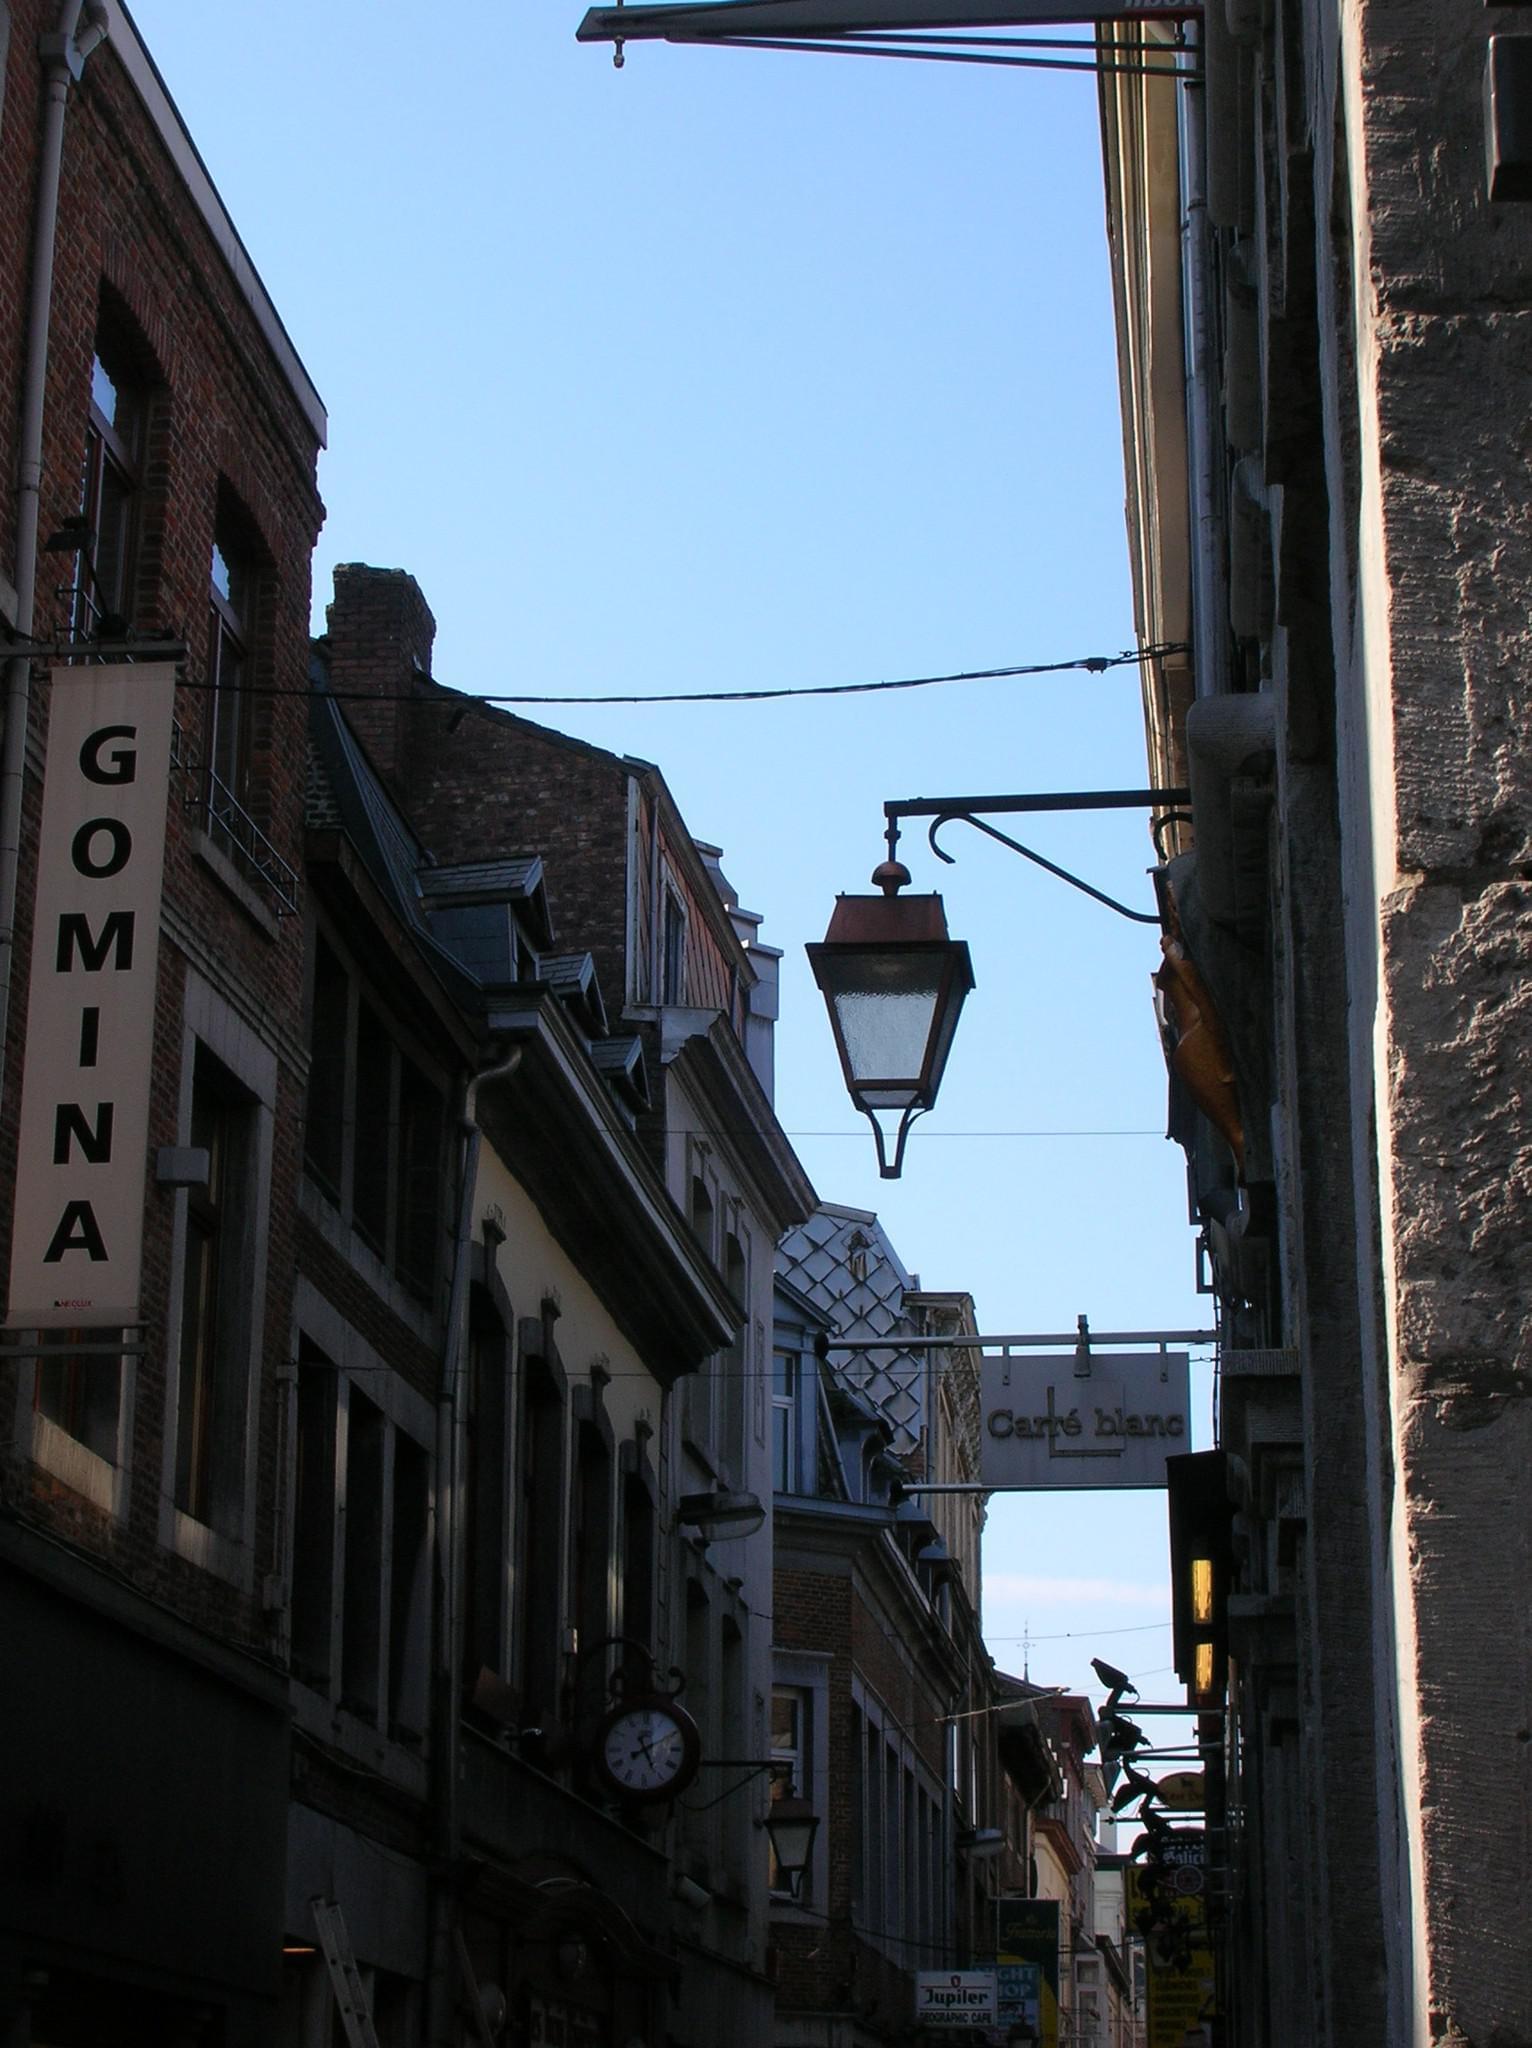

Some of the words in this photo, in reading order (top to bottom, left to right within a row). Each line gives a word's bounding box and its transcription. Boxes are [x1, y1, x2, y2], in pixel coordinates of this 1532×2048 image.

[43, 725, 137, 1264] GOMINA
[988, 1408, 1082, 1438] Carré
[1095, 1407, 1185, 1438] blanc
[924, 1989, 988, 2007] Jupiler
